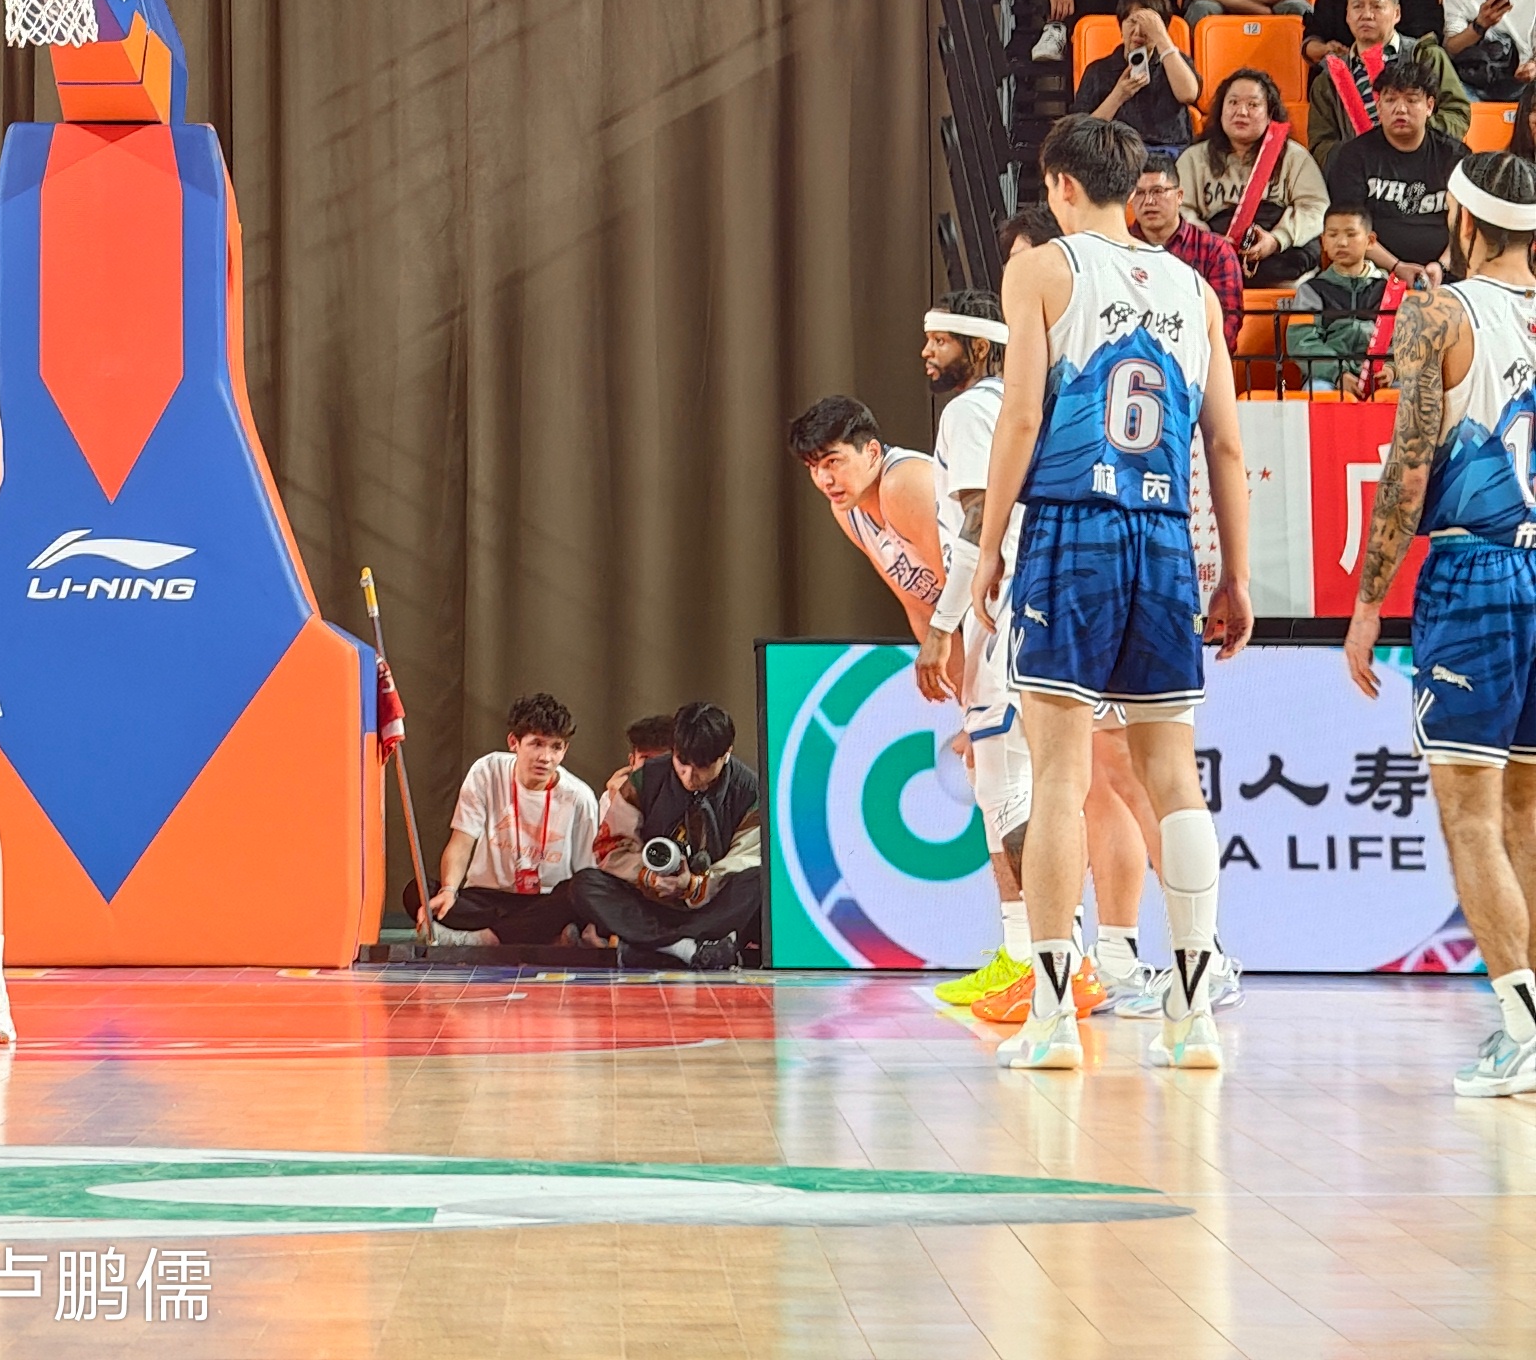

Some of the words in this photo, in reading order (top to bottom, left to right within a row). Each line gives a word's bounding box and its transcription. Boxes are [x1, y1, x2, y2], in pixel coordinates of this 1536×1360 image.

[1099, 300, 1184, 343] 伊力特
[1104, 358, 1166, 454] 6
[26, 575, 198, 602] LI-NING
[1287, 835, 1427, 871] LIFE
